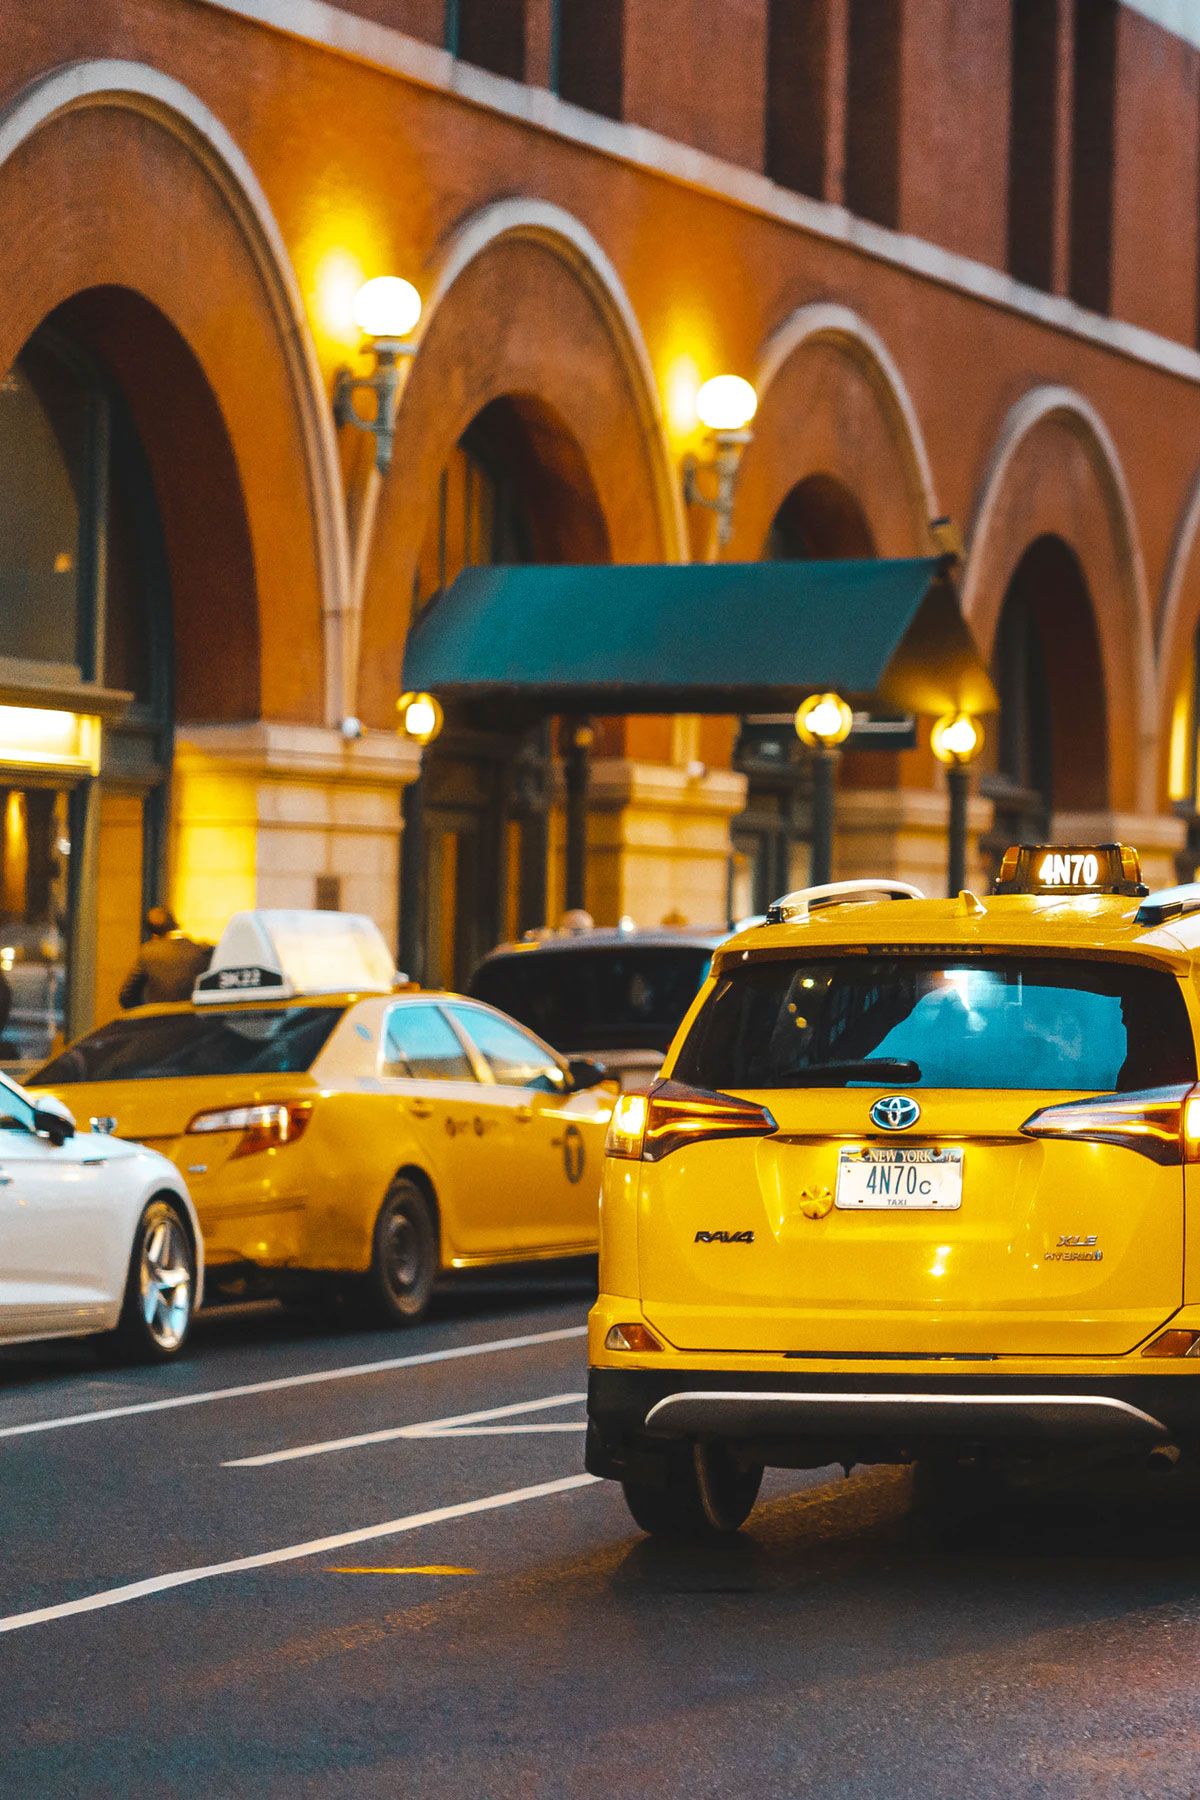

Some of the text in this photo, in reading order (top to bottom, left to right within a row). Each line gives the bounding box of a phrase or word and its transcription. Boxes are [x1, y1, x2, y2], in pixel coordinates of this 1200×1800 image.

[1038, 853, 1099, 885] 4N70
[869, 1149, 931, 1162] NEW YORK
[694, 1231, 754, 1243] RAV4
[1056, 1235, 1097, 1247] XLE
